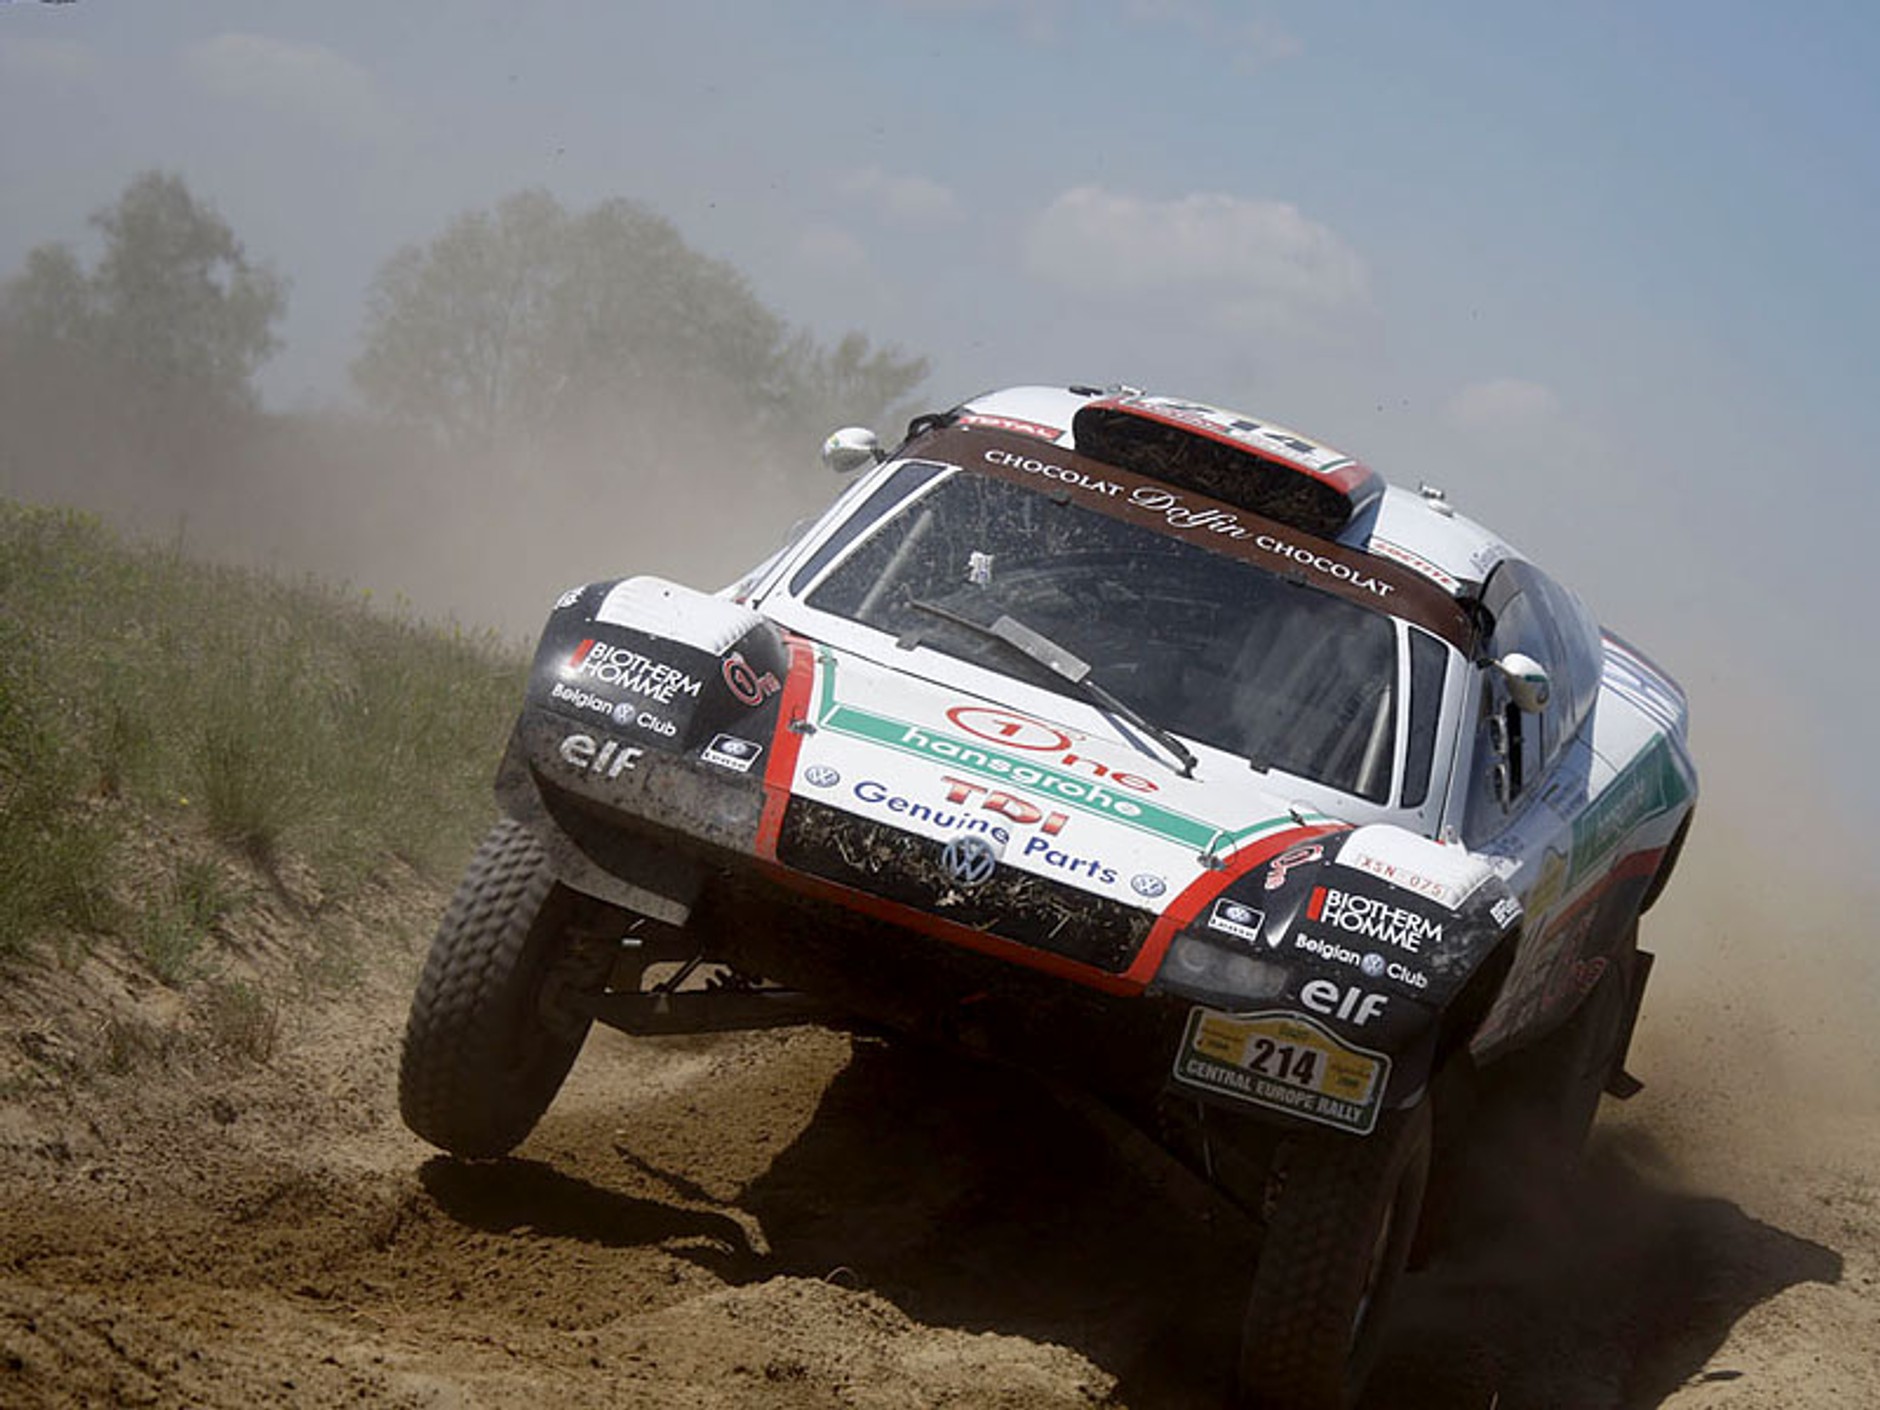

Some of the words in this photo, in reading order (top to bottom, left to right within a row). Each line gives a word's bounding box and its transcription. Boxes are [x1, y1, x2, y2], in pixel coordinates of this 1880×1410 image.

[984, 450, 1124, 497] CHOCOLAT
[1127, 486, 1253, 540] Dolfin
[1256, 535, 1395, 597] CHOCOLAT
[577, 659, 677, 704] HOMME
[589, 642, 703, 698] BIOTHERM
[552, 683, 614, 715] Belgian
[636, 712, 677, 737] Club
[559, 734, 644, 778] elf
[901, 726, 1144, 817] hansgrohe
[853, 780, 1010, 845] Genuine
[1022, 836, 1117, 884] Parts
[941, 775, 1069, 837] TDI
[1319, 904, 1422, 953] HOMME
[1325, 889, 1443, 942] BIOTHERM
[1295, 933, 1361, 967] Belgian
[1386, 962, 1428, 989] Club
[1301, 979, 1389, 1027] elf
[1250, 1038, 1318, 1085] 214
[1186, 1060, 1252, 1090] CENTRAL
[1255, 1080, 1314, 1110] EUROPE
[1317, 1096, 1364, 1123] RALLY
